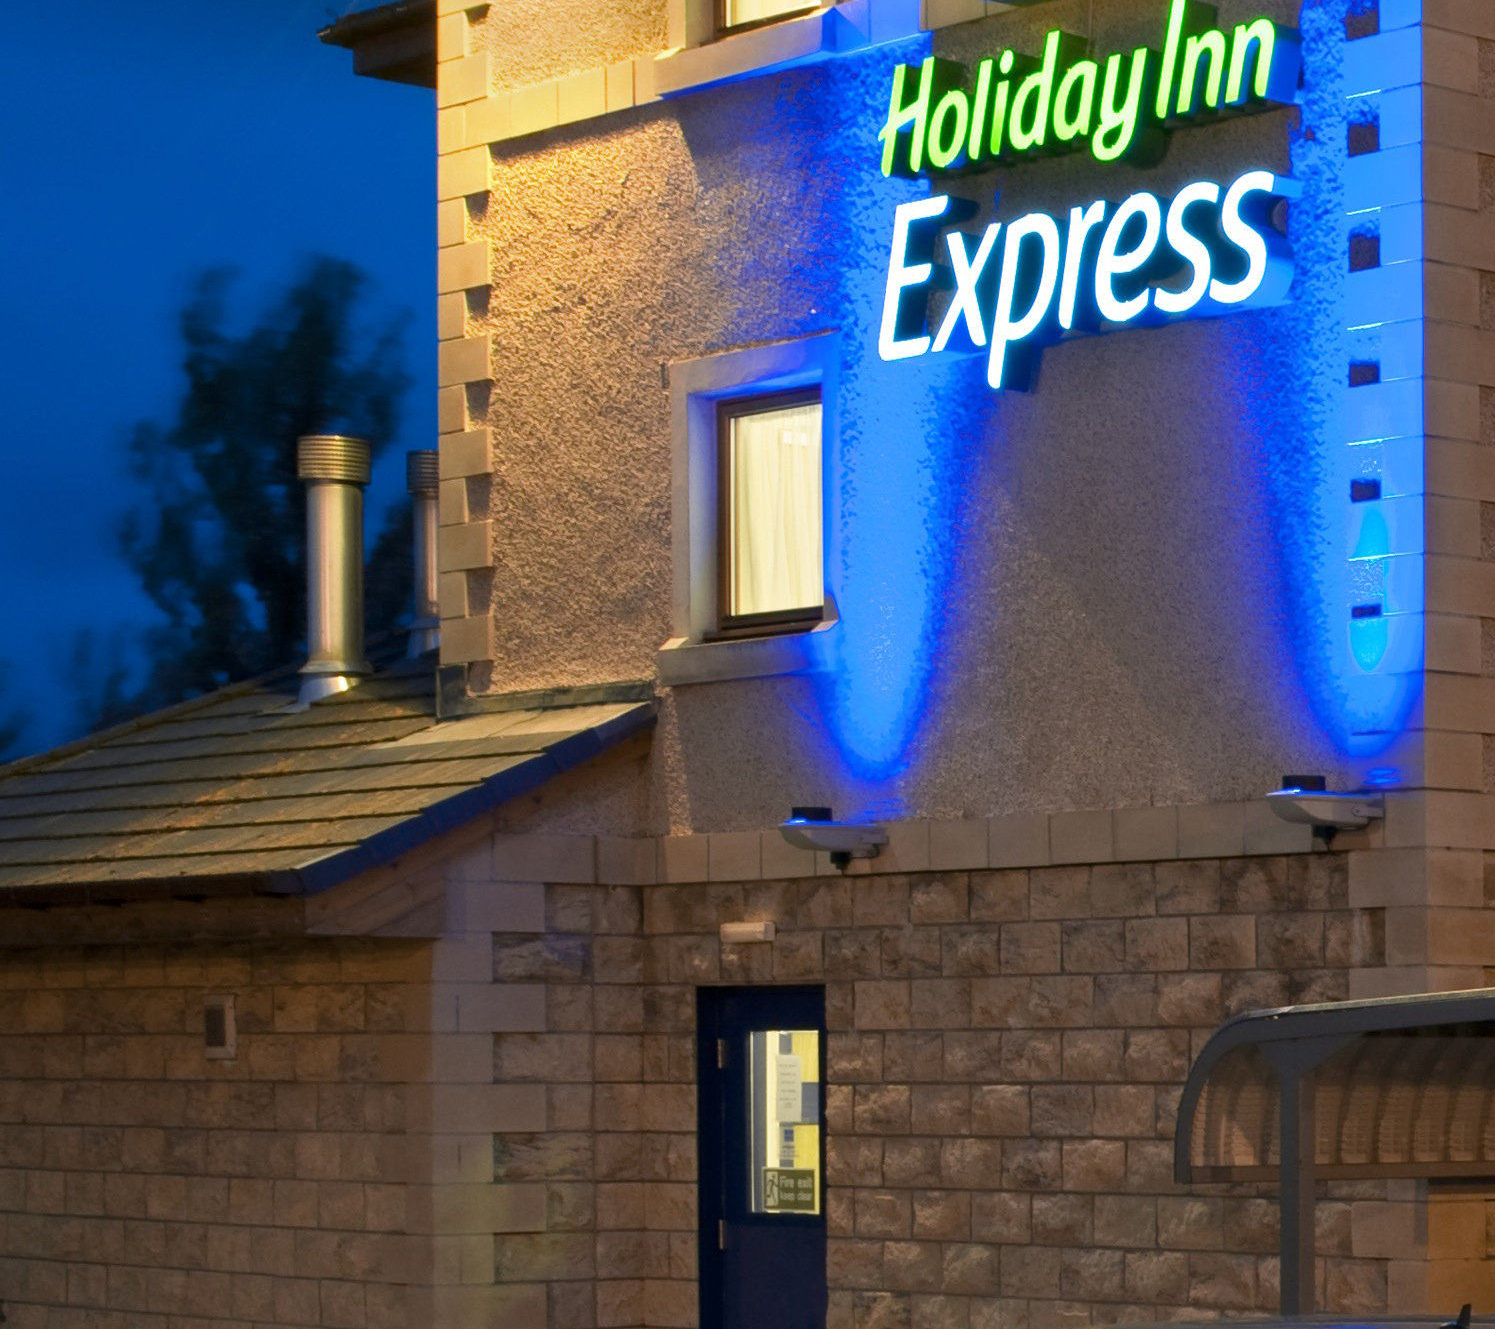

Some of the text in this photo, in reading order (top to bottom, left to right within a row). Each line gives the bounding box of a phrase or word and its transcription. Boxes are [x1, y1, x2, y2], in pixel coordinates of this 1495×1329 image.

[878, 29, 1147, 179] Holiday
[878, 169, 1277, 390] Express
[780, 1174, 813, 1189] Fire exit
